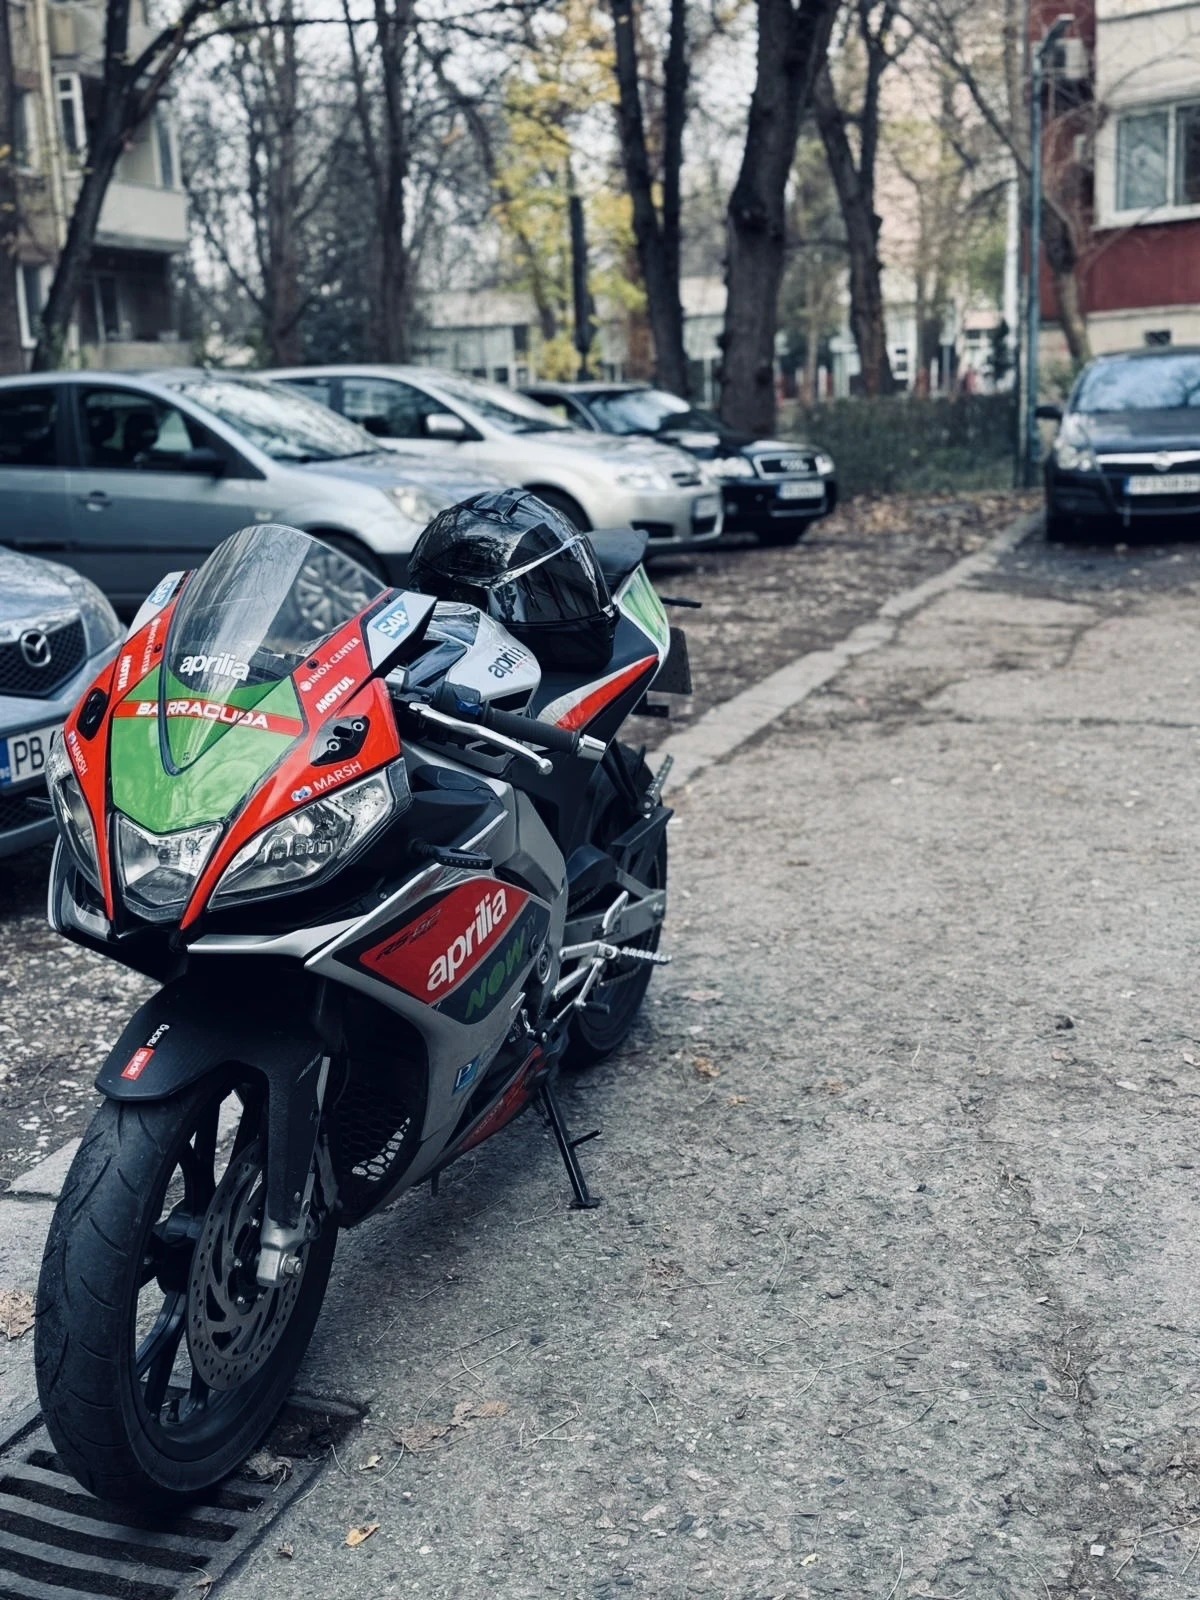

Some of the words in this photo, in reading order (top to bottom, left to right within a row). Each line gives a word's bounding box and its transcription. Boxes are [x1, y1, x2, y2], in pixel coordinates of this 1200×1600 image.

[378, 609, 408, 636] SAP
[180, 652, 251, 681] aprilia
[308, 662, 333, 684] INOX
[331, 637, 361, 667] CENTER
[316, 676, 355, 714] MOTUL
[136, 701, 269, 729] BARRACUDA
[72, 741, 88, 776] MARSH
[313, 761, 363, 791] MARSH
[427, 888, 508, 992] aprilia
[466, 926, 526, 1019] NOW
[146, 1024, 171, 1047] racing
